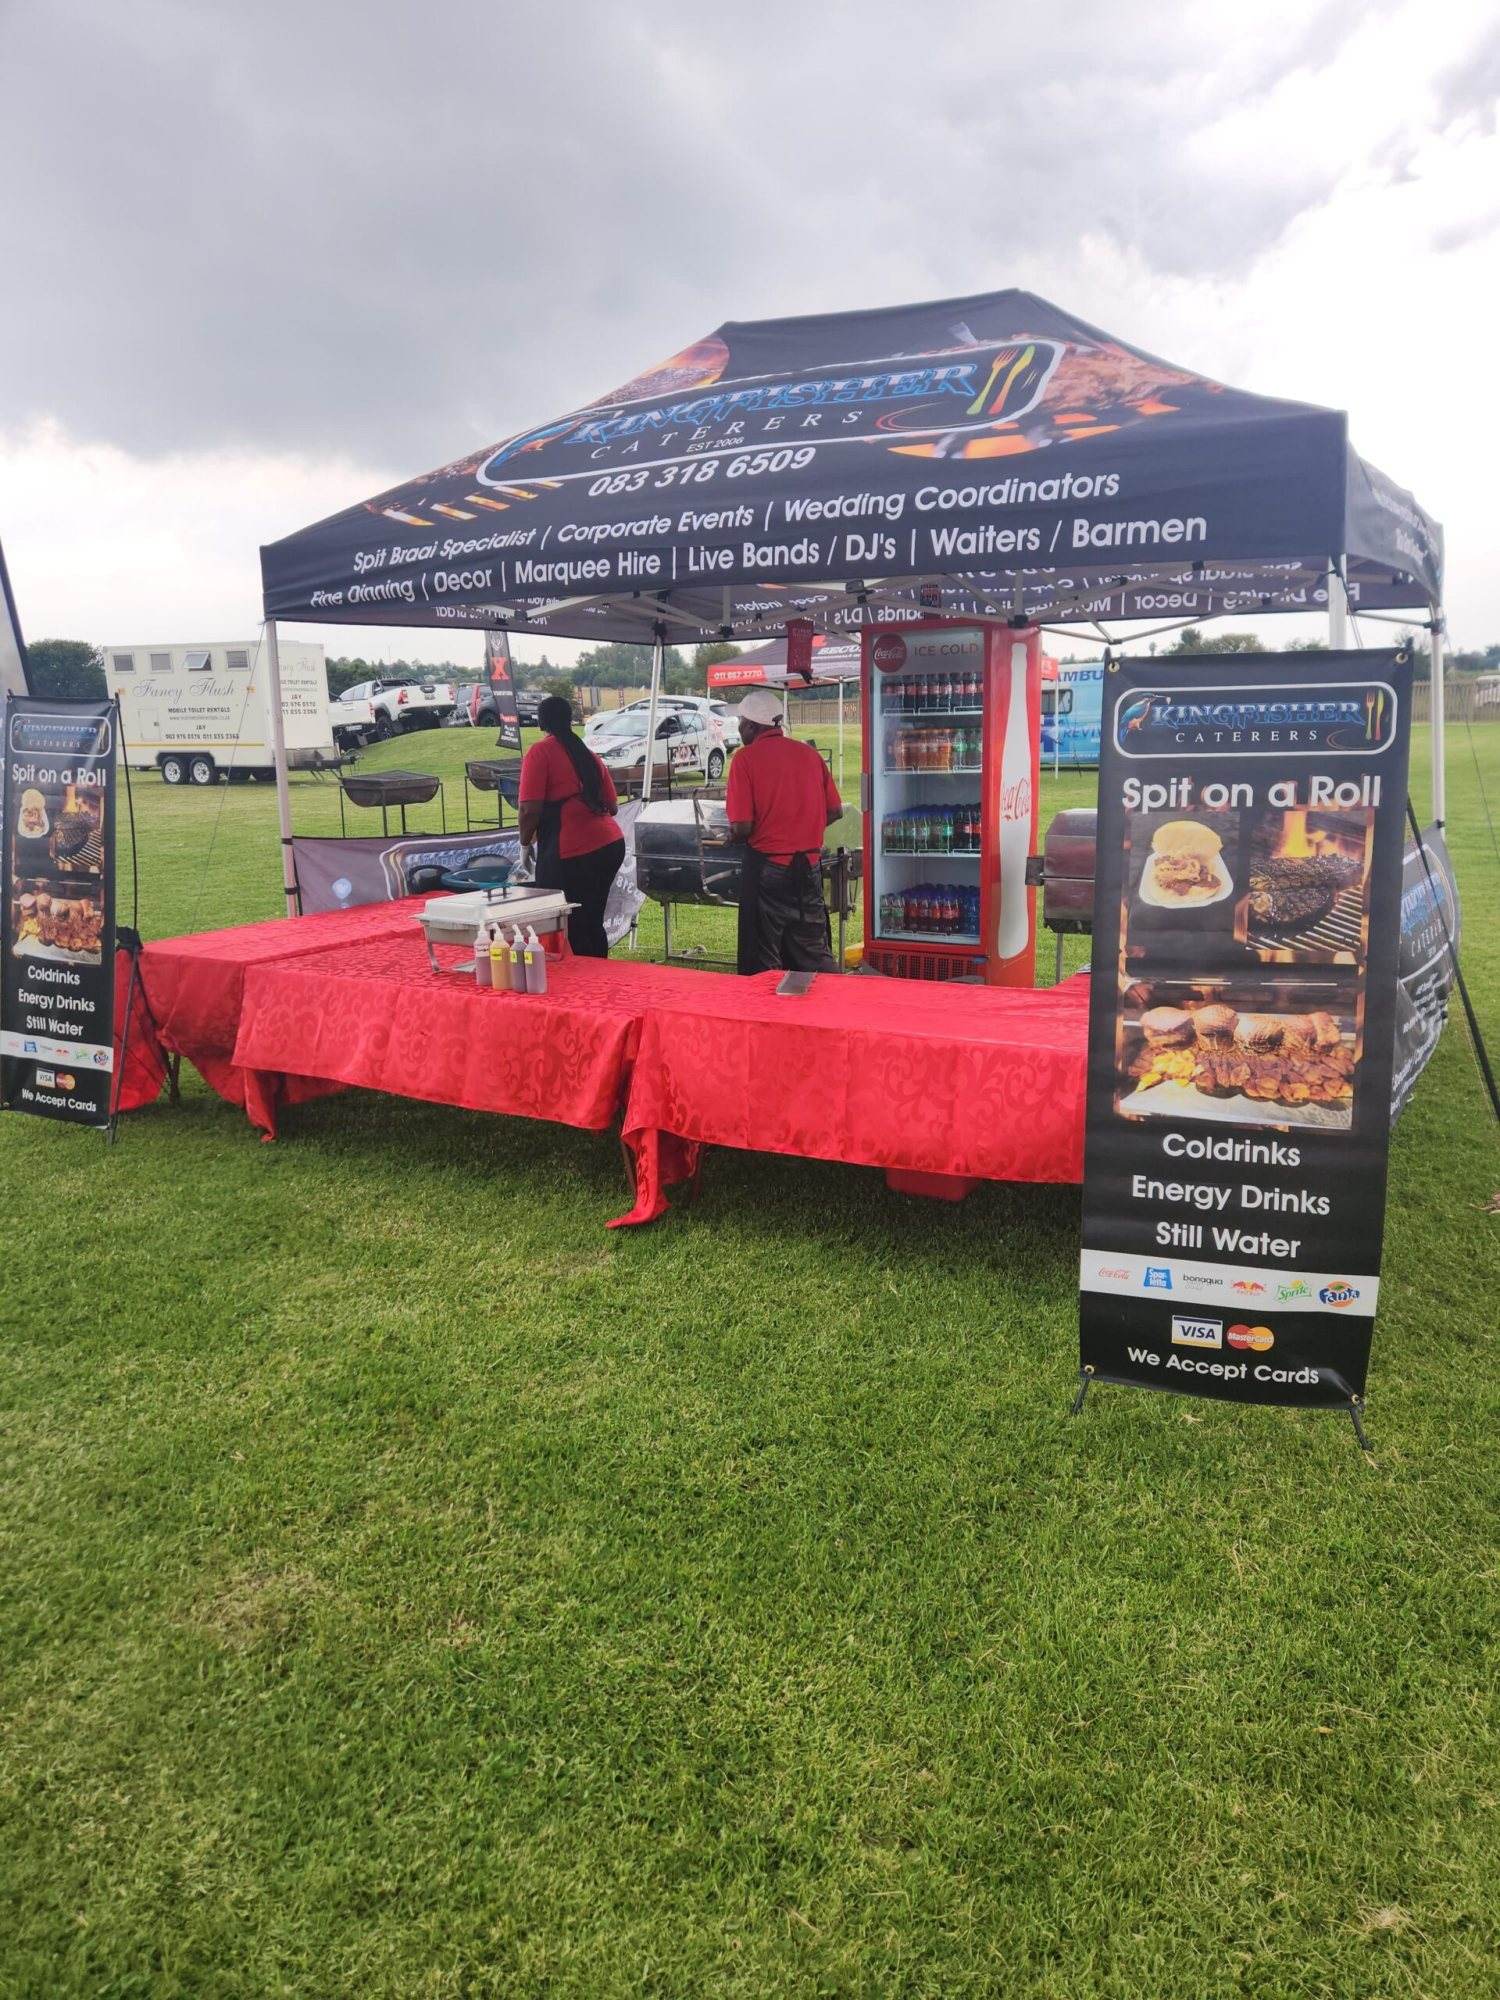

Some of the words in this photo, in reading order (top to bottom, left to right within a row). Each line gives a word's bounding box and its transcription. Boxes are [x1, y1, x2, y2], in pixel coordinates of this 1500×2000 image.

[564, 363, 978, 444] KINGFISHER
[590, 410, 863, 460] CATERERS
[686, 440, 714, 455] EST
[713, 436, 745, 450] 2006
[588, 472, 647, 498] 083
[654, 456, 715, 488] 318
[726, 447, 817, 479] 6509
[353, 549, 387, 574] Spit
[389, 541, 439, 566] Braai
[439, 528, 536, 560] Specialist
[557, 514, 672, 544] Corporate
[677, 504, 754, 533] Events
[785, 492, 906, 521] Wedding
[914, 472, 1120, 511] Coordinators
[310, 590, 343, 608] Fine
[347, 578, 415, 603] Dinning
[433, 569, 492, 593] Decor
[515, 557, 610, 586] Marquee
[617, 551, 661, 576] Hire
[688, 545, 734, 571] Live
[742, 538, 820, 568] Bands
[845, 532, 896, 561] DJ's
[930, 525, 1040, 556] Waiters
[1072, 517, 1207, 548] Barmen
[914, 645, 937, 657] ICE
[940, 643, 978, 656] COLD
[132, 679, 183, 704] Fancy
[190, 677, 235, 698] Flush
[1151, 702, 1366, 729] KINGFISHER
[1175, 730, 1318, 743] CATERERS
[12, 763, 35, 784] Spit
[38, 767, 57, 783] on
[60, 769, 72, 784] a
[76, 767, 107, 787] Roll
[1122, 777, 1192, 815] Spit
[1203, 783, 1254, 808] on
[1268, 781, 1295, 808] a
[1310, 775, 1382, 808] Roll
[27, 965, 80, 985] Coldrinks
[18, 988, 54, 1009] Energy
[56, 994, 95, 1012] Drinks
[26, 1015, 46, 1031] Still
[48, 1017, 84, 1036] Water
[21, 1088, 34, 1100] We
[35, 1092, 66, 1108] Accept
[67, 1098, 97, 1112] Cards
[1162, 1133, 1301, 1167] Coldrinks
[1132, 1174, 1232, 1211] Energy
[1240, 1184, 1331, 1216] Drinks
[1156, 1221, 1203, 1249] Still
[1211, 1226, 1301, 1258] Water
[1183, 1274, 1224, 1286] bonaqua
[1279, 1284, 1310, 1301] Sprite
[1318, 1287, 1361, 1303] Fanta
[1180, 1323, 1216, 1340] VISA
[1127, 1346, 1161, 1367] We
[1166, 1354, 1248, 1381] Accept
[1254, 1364, 1320, 1385] Cards
